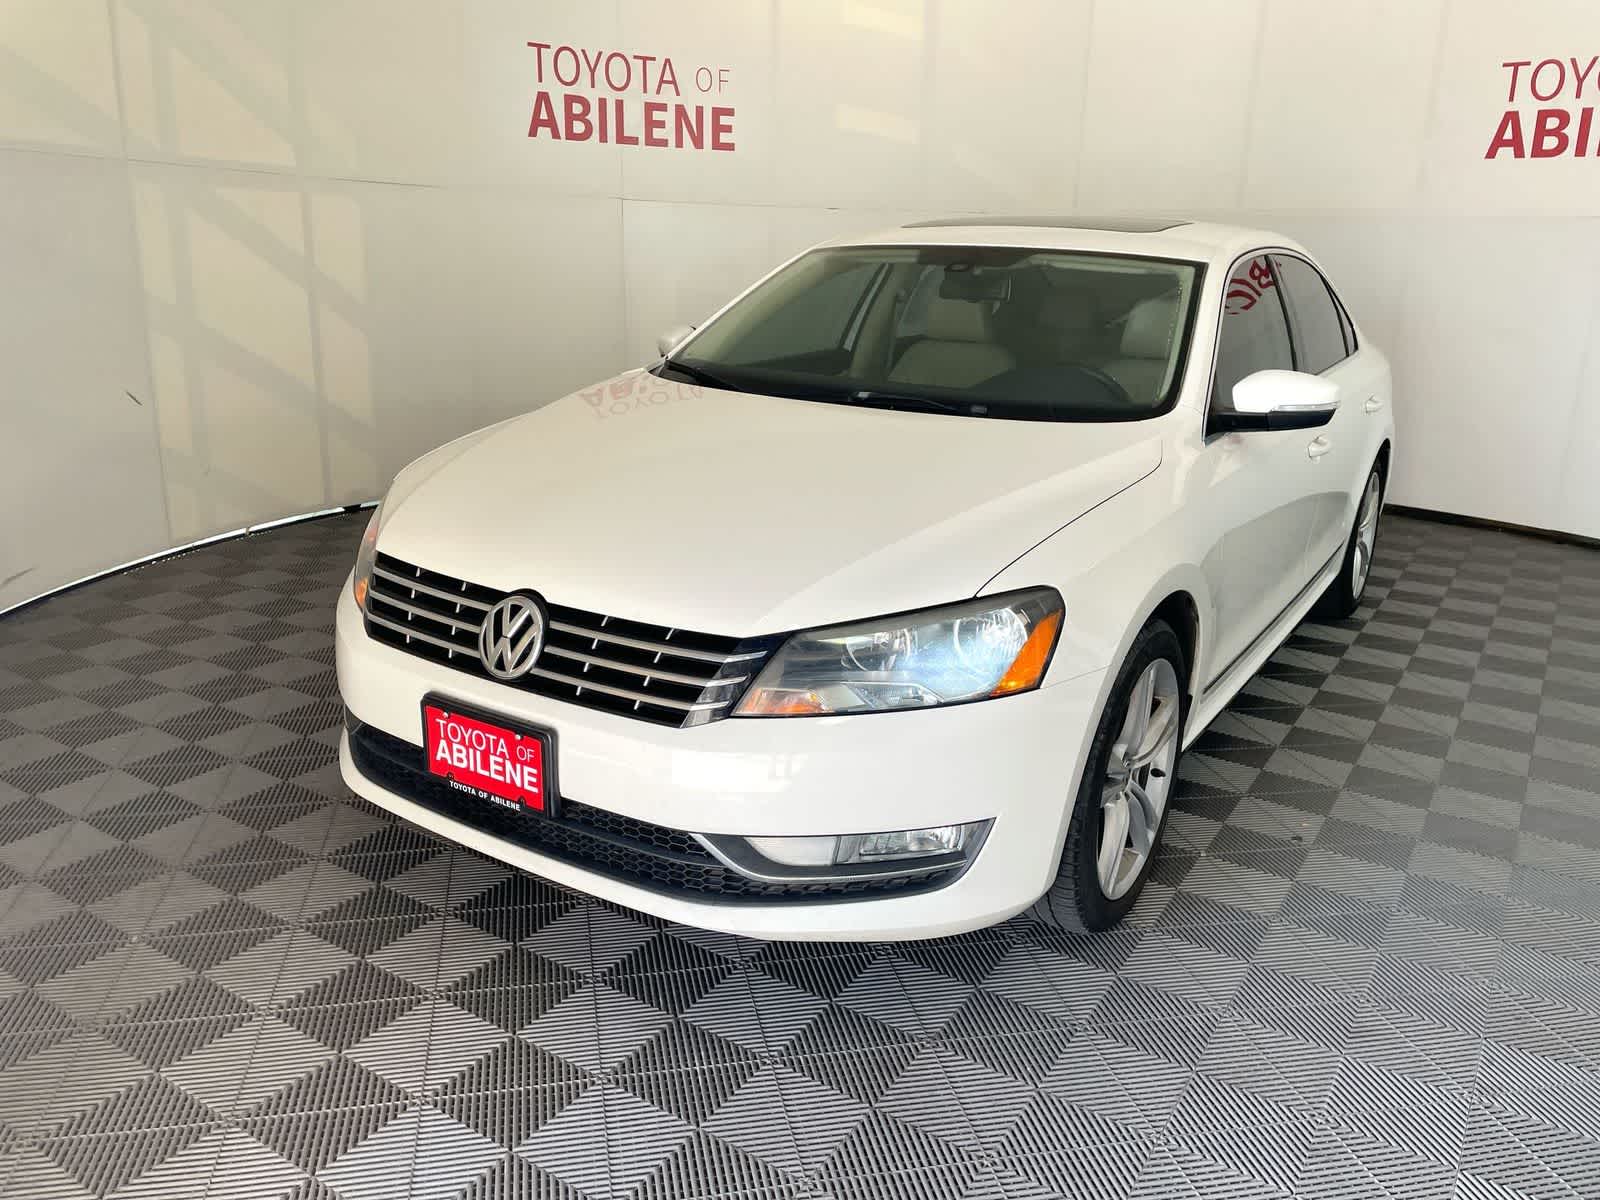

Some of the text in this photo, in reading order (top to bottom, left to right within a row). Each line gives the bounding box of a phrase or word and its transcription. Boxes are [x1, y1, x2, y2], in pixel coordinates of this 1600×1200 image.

[527, 41, 730, 97] TOYOTA OF
[1502, 55, 1600, 102] TOY
[527, 91, 736, 151] ABILENE
[1484, 106, 1600, 159] ABI
[435, 718, 535, 762] TOYOTA OF
[435, 739, 539, 793] ABILENE
[449, 780, 521, 811] TOYOTA OF ABILENE
